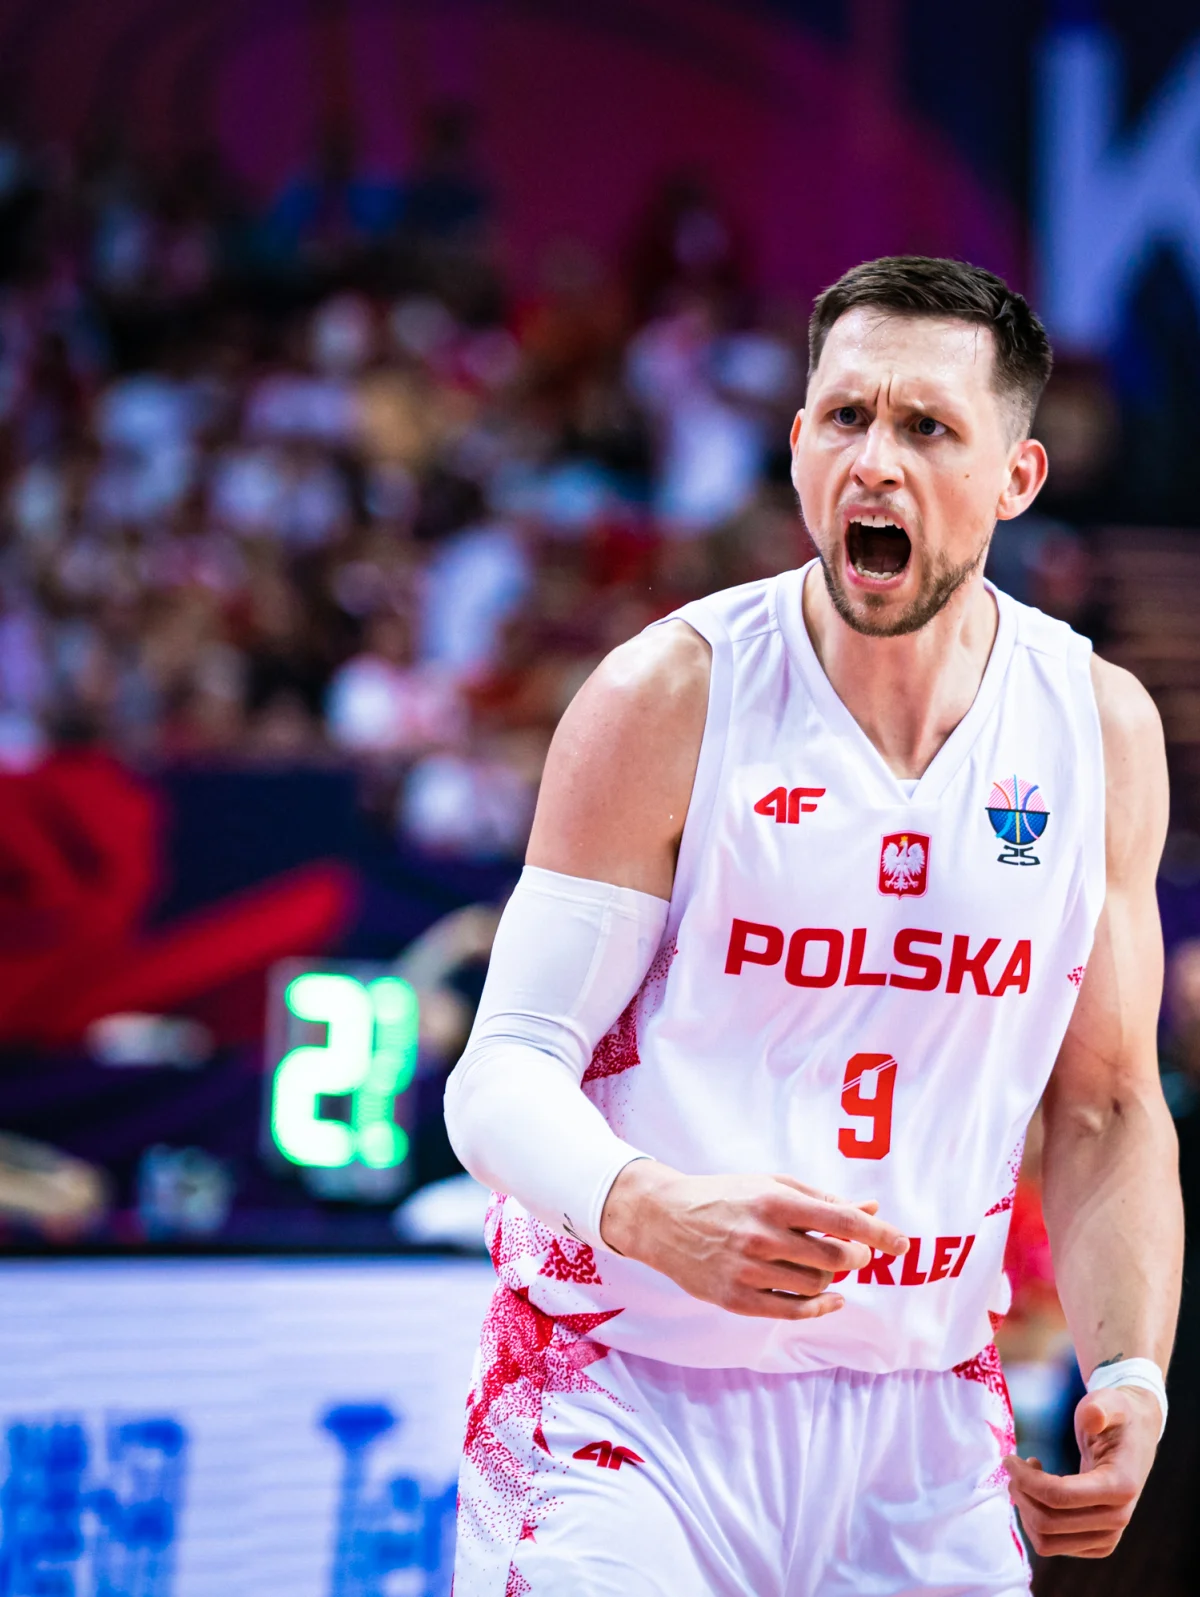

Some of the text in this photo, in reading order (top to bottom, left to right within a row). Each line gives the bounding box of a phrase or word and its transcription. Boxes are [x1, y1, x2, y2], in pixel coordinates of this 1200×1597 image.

[754, 786, 826, 824] 4F
[725, 918, 1032, 997] POLSKA
[838, 1053, 898, 1160] 9
[822, 1234, 976, 1286] RLE
